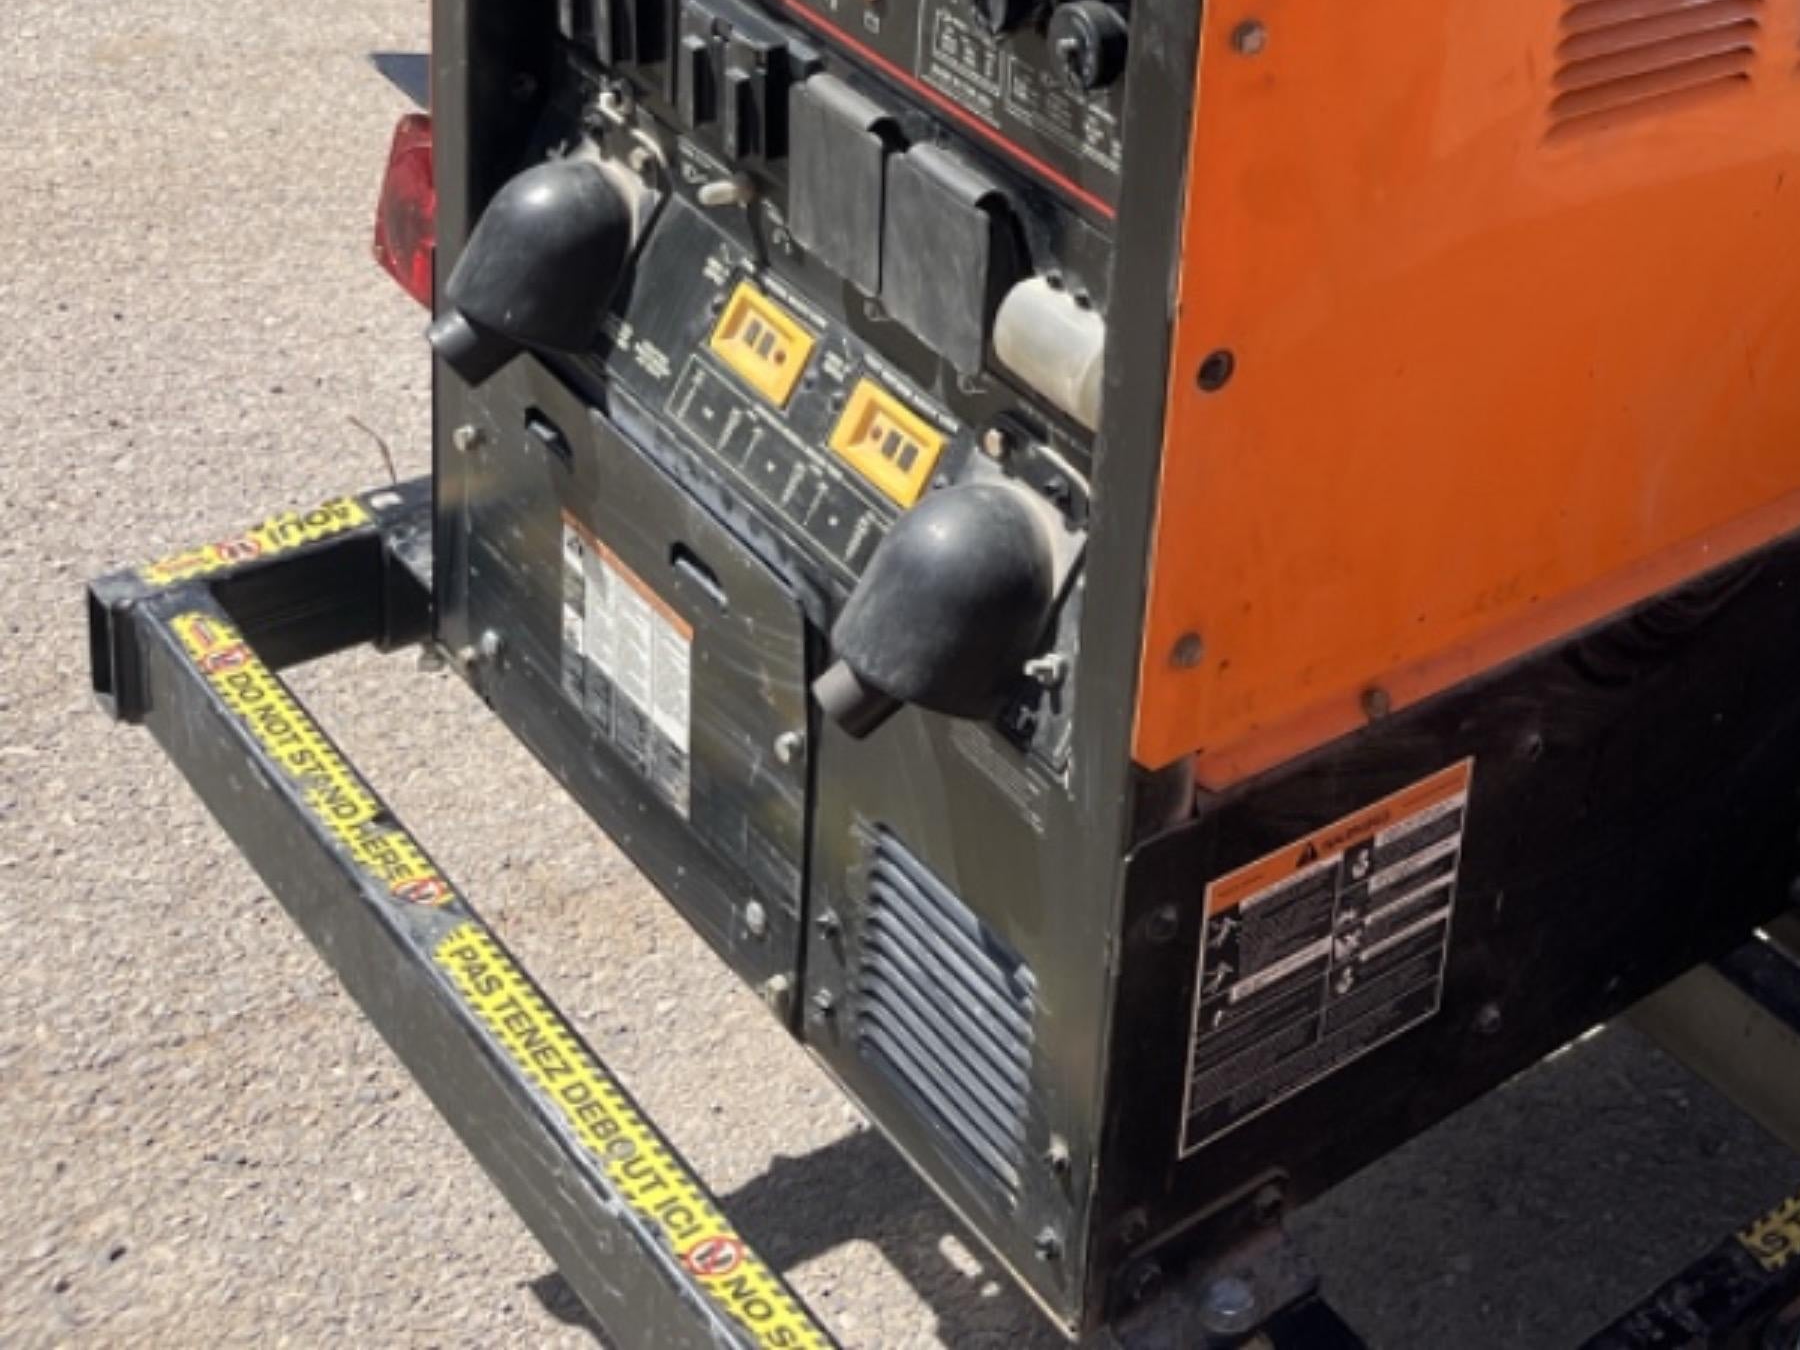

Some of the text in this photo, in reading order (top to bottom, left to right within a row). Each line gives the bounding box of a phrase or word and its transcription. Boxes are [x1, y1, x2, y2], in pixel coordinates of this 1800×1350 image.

[226, 670, 266, 703] DO
[250, 703, 304, 748] NOT
[287, 747, 361, 821] STAND
[449, 945, 704, 1241] PAS TENEZ DEBOUT ICI
[720, 1273, 775, 1322] NO
